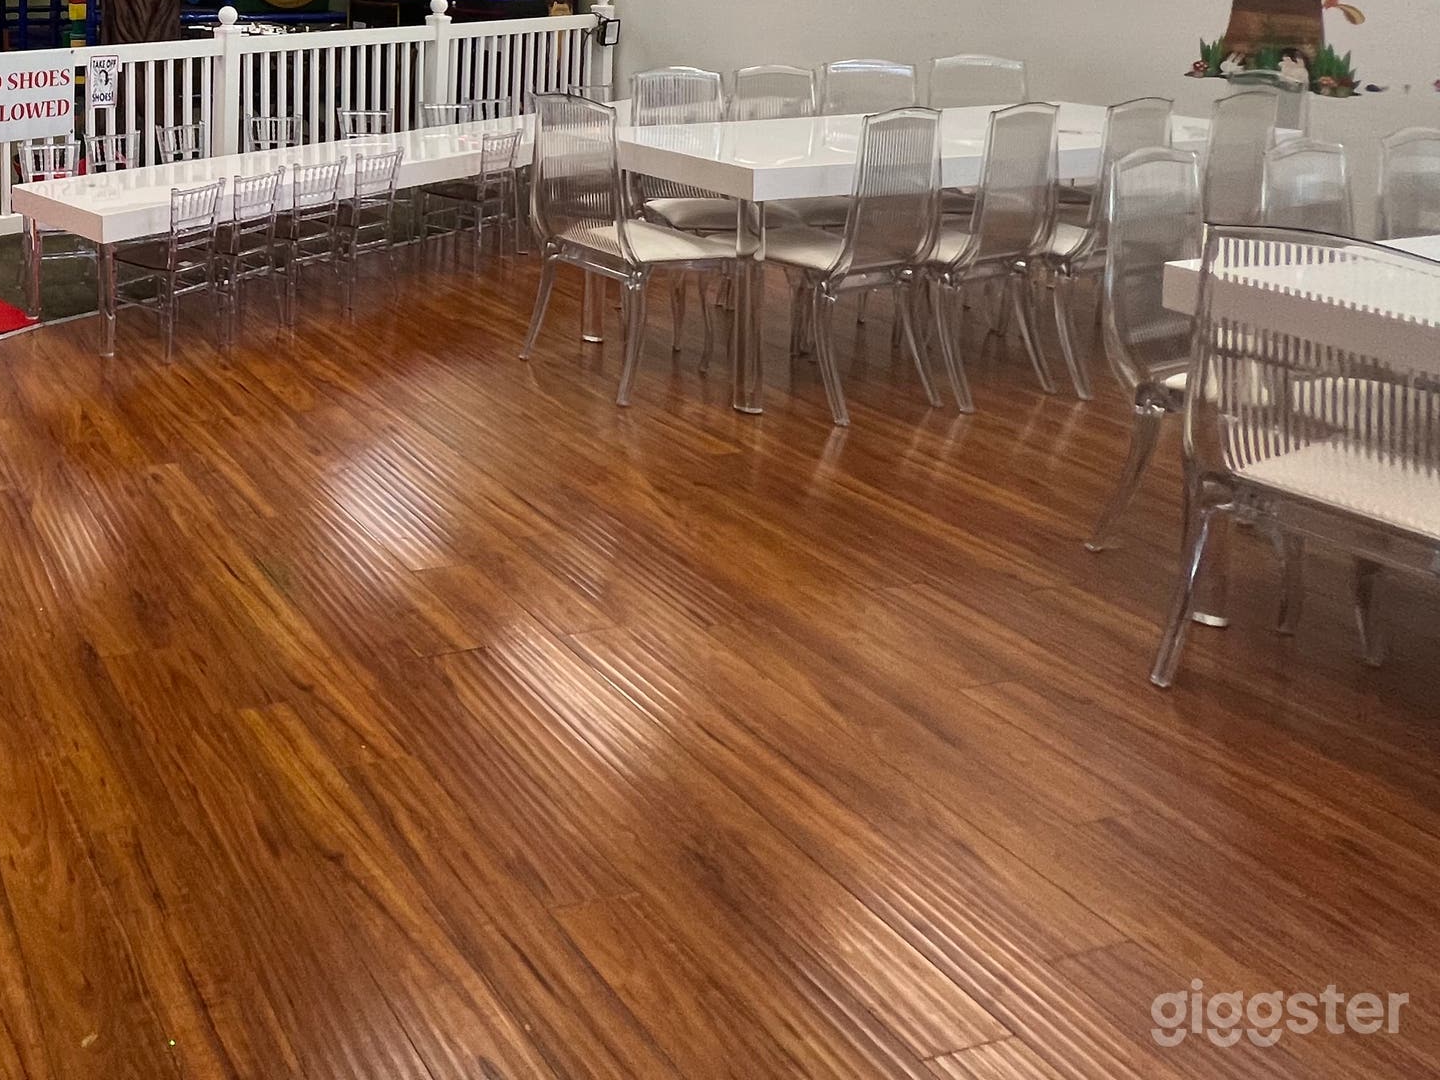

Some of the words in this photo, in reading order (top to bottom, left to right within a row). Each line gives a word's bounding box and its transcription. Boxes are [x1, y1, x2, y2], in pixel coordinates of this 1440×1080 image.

[92, 59, 105, 69] TAKE
[106, 59, 117, 68] OFF
[7, 68, 70, 91] SHOES
[92, 91, 114, 102] SHOES!
